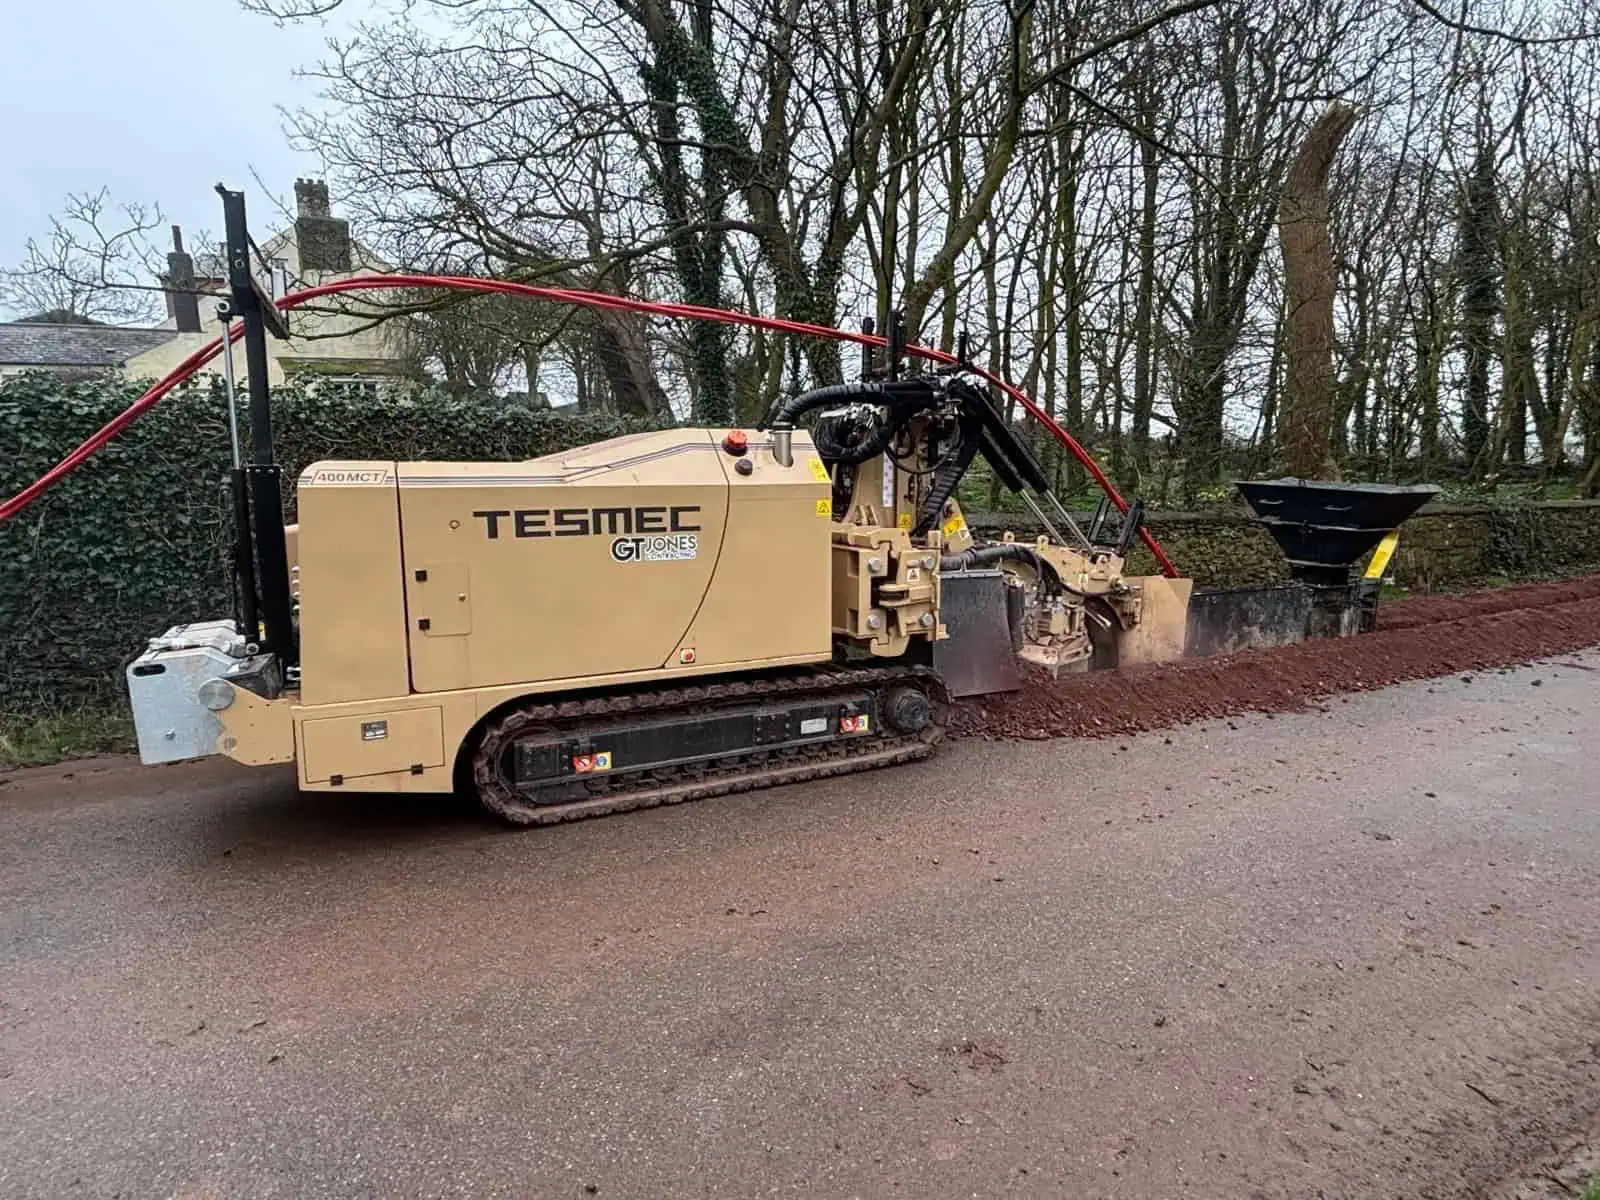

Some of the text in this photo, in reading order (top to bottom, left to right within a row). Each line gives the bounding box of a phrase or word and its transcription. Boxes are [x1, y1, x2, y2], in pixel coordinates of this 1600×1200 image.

[472, 506, 701, 539] TESMEC
[612, 536, 697, 561] GT JONES
